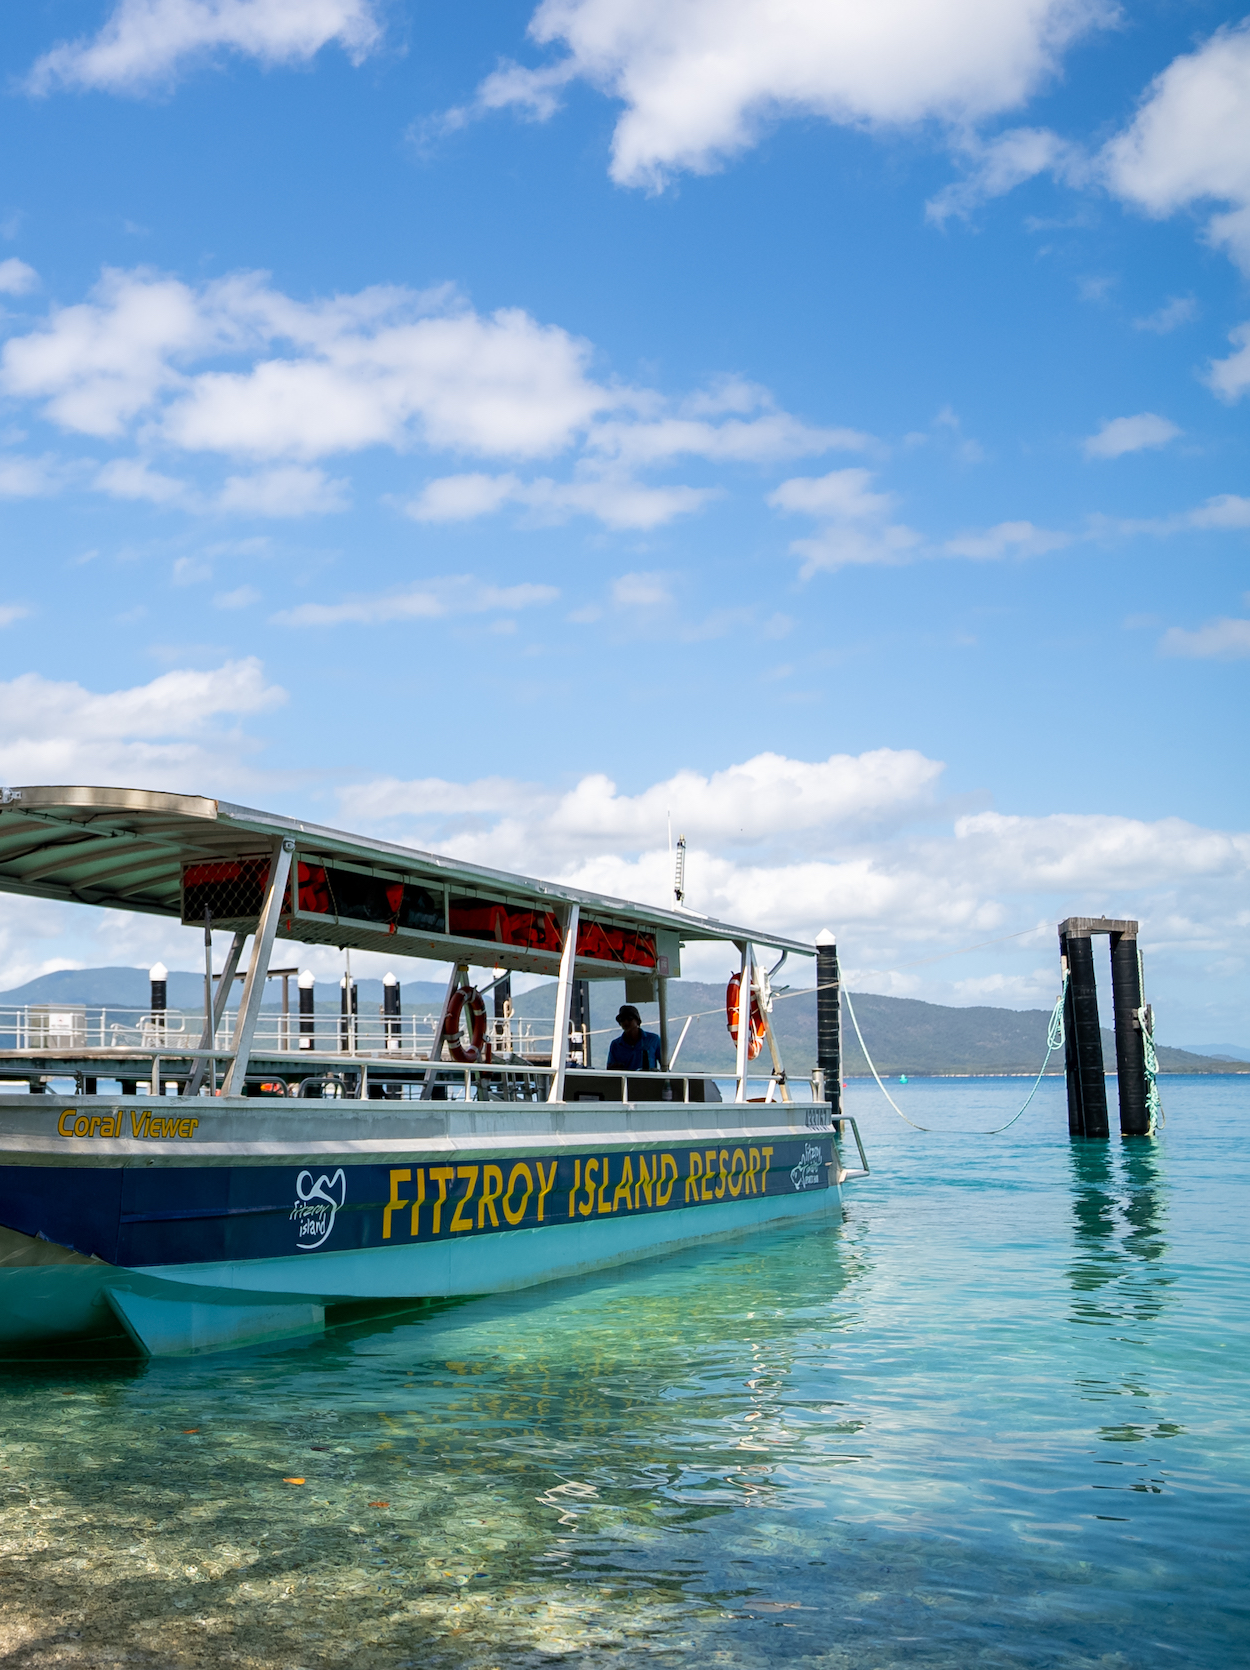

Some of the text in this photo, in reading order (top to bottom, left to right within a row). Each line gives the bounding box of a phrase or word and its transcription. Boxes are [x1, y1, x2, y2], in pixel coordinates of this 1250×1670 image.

[58, 1109, 199, 1138] Coral Viewer
[382, 1146, 773, 1239] FITZROY ISLAND RESORT
[299, 1213, 326, 1237] island
